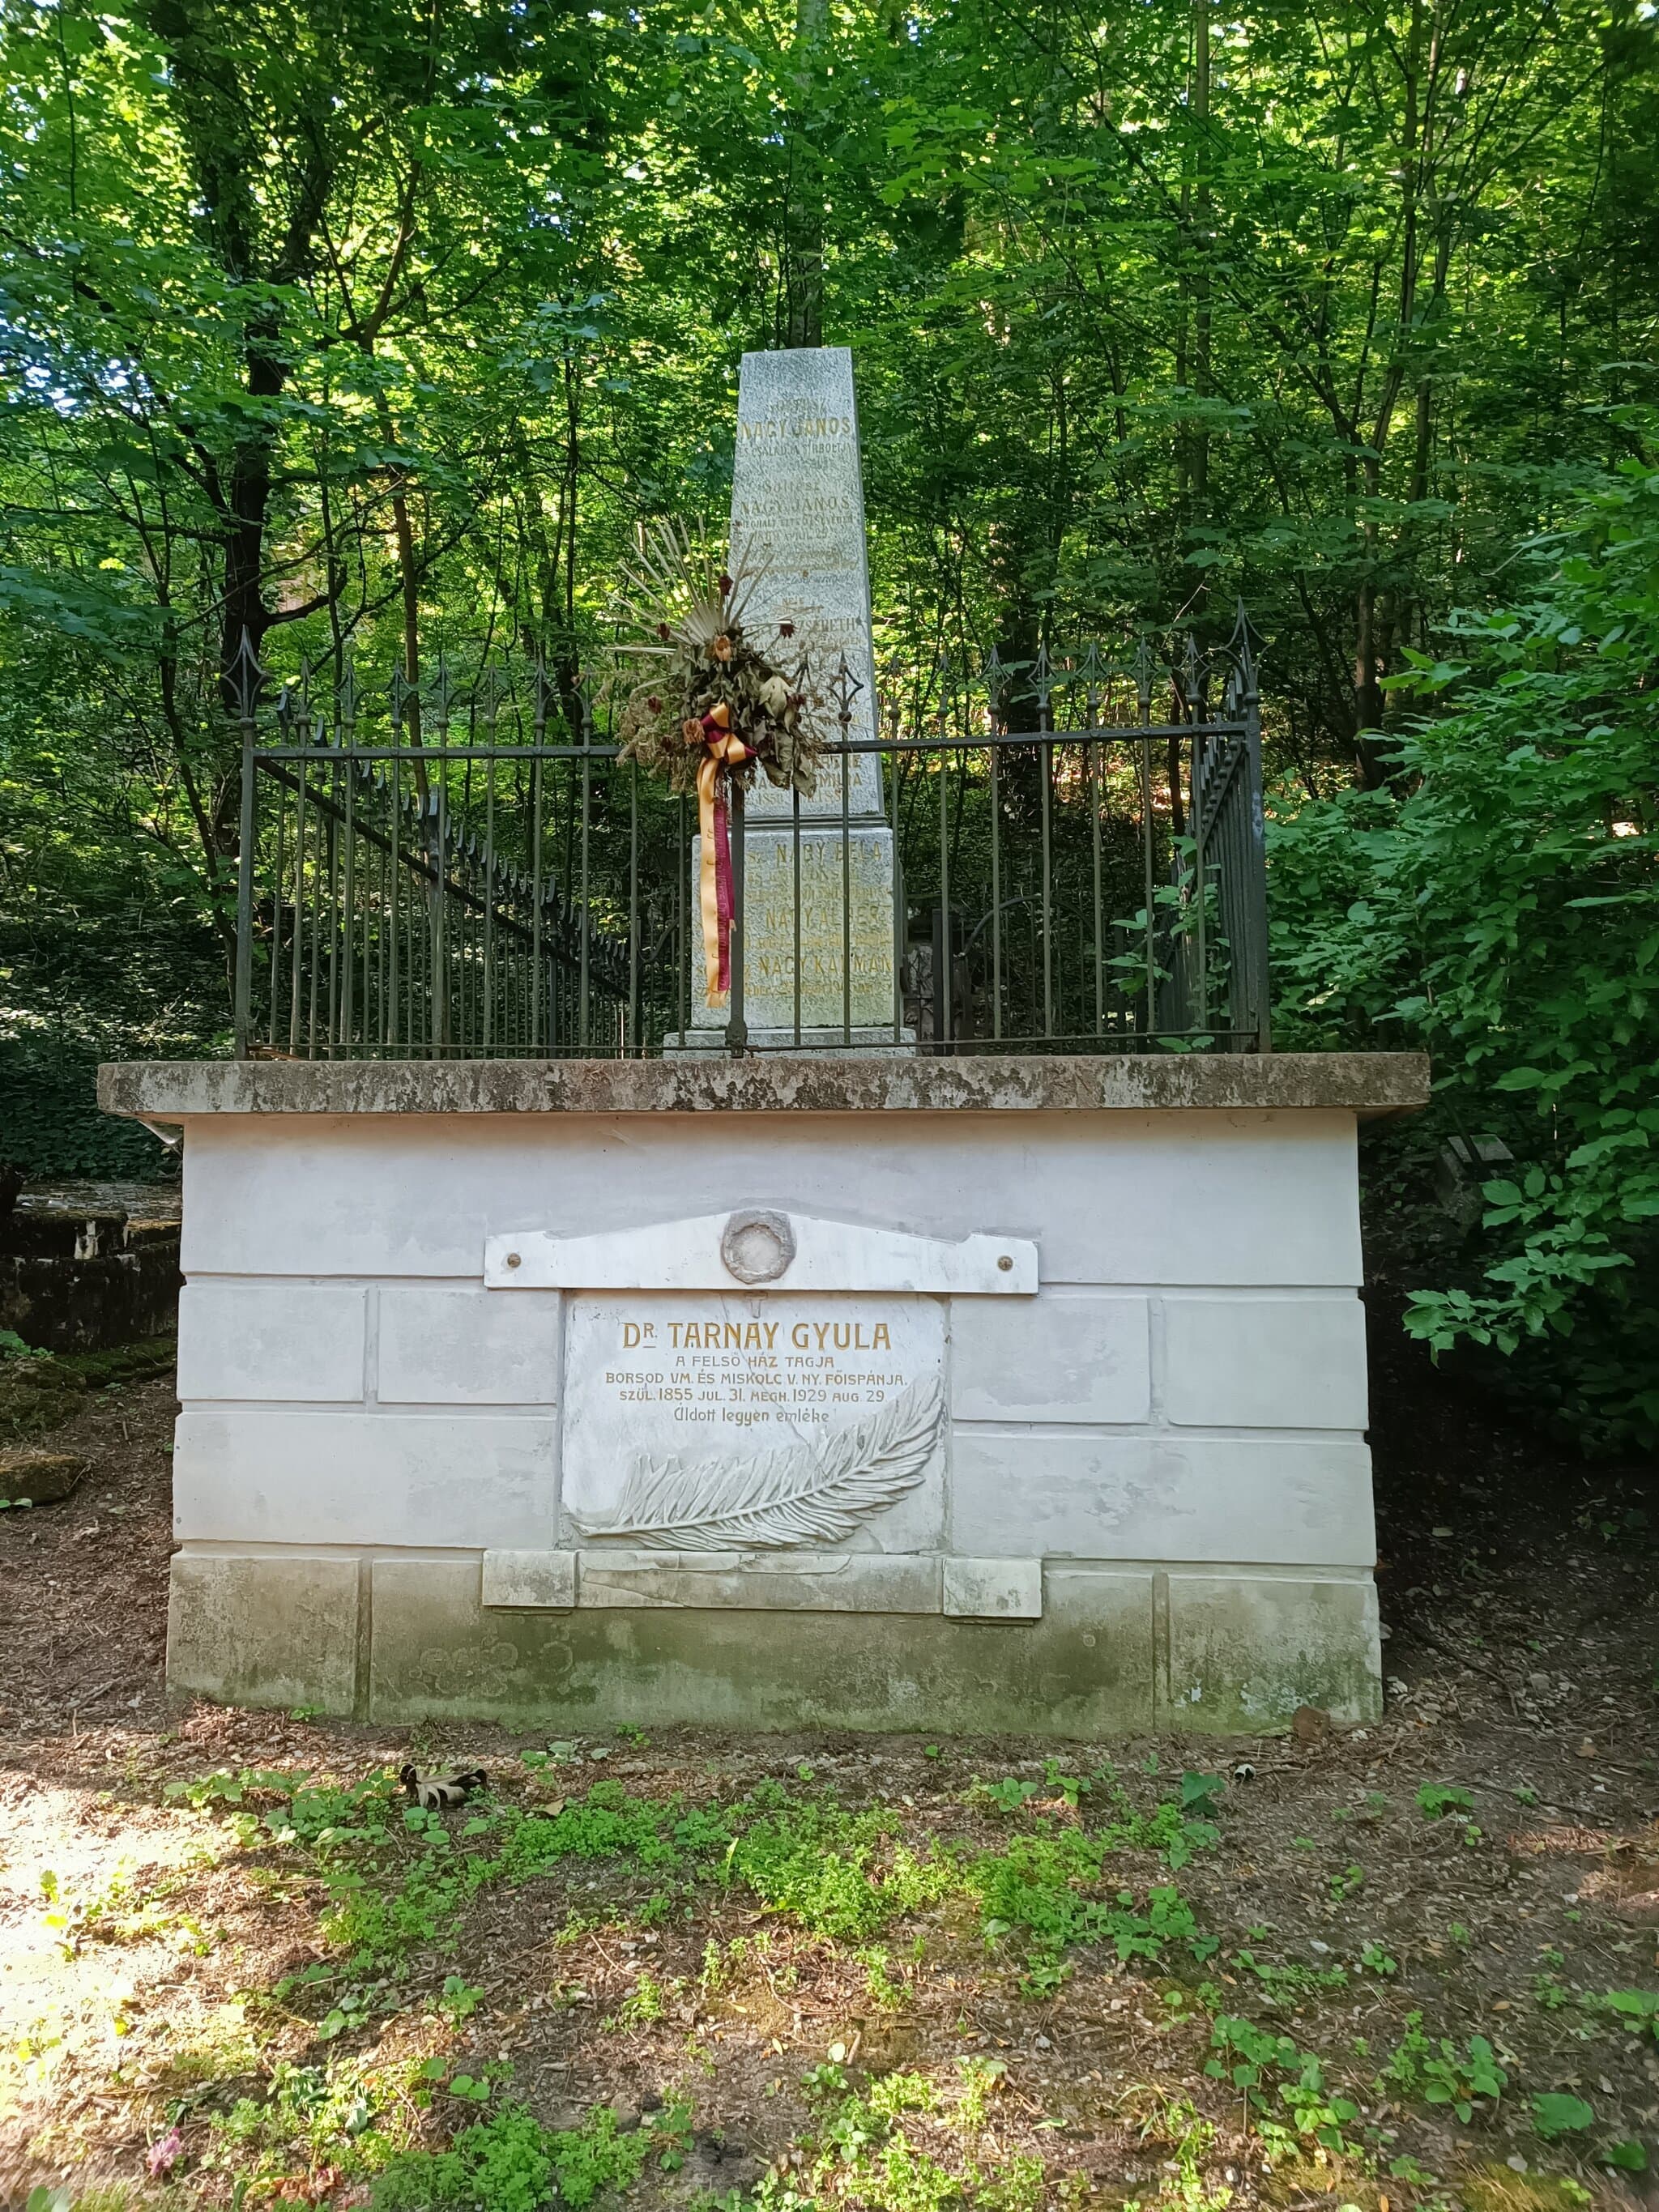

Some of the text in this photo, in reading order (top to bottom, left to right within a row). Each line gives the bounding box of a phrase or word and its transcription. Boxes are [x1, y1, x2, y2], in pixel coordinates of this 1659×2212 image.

[667, 1322, 779, 1350] TARNAY
[791, 1322, 892, 1350] GYULA
[676, 1355, 685, 1367] A
[748, 1351, 778, 1367] HÁZ
[785, 1356, 834, 1368] TAGJA
[605, 1372, 664, 1384] BORSOD
[670, 1373, 694, 1384] VM.
[697, 1368, 715, 1384] ÉS
[720, 1373, 782, 1385] MISKOLC
[802, 1374, 822, 1385] NY.
[619, 1387, 656, 1401] SZÜL.
[659, 1387, 693, 1401] 1855
[697, 1391, 726, 1401] JUL.
[729, 1388, 745, 1402] 31.
[750, 1392, 790, 1402] MEGH.
[793, 1388, 827, 1402] 1929
[722, 1407, 770, 1426] legyen
